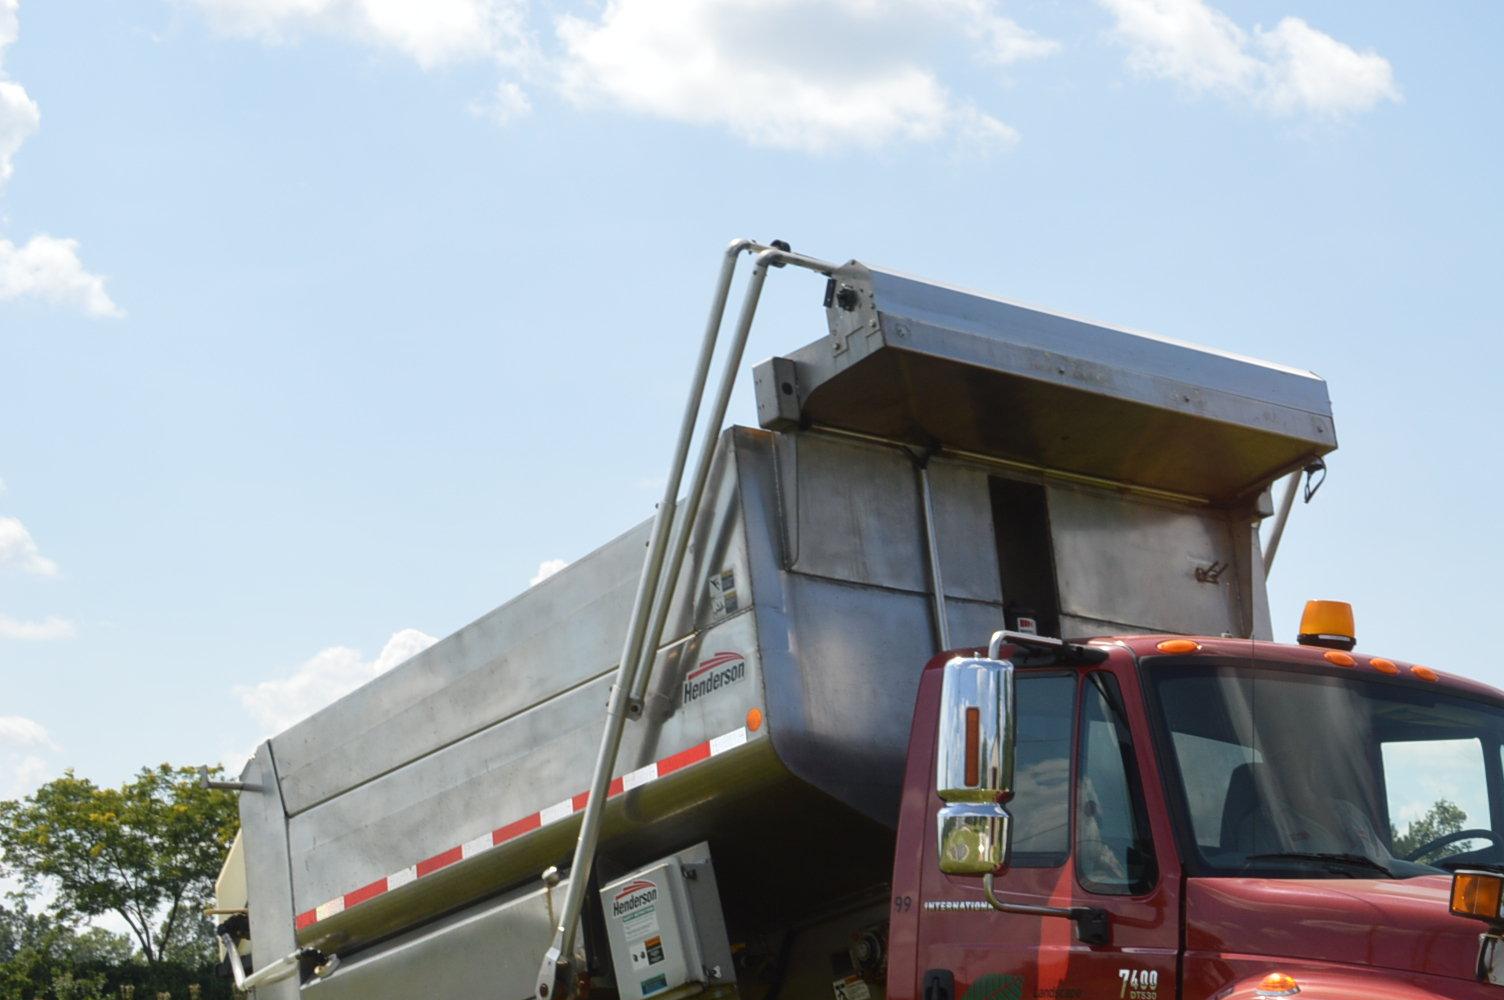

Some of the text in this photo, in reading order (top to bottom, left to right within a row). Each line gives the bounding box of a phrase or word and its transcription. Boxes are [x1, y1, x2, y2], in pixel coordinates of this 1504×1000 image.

[684, 661, 745, 703] Henderson
[613, 889, 657, 917] Henderson
[895, 896, 912, 912] 99
[924, 901, 998, 911] INTERNATIONA
[1119, 969, 1158, 999] 7400
